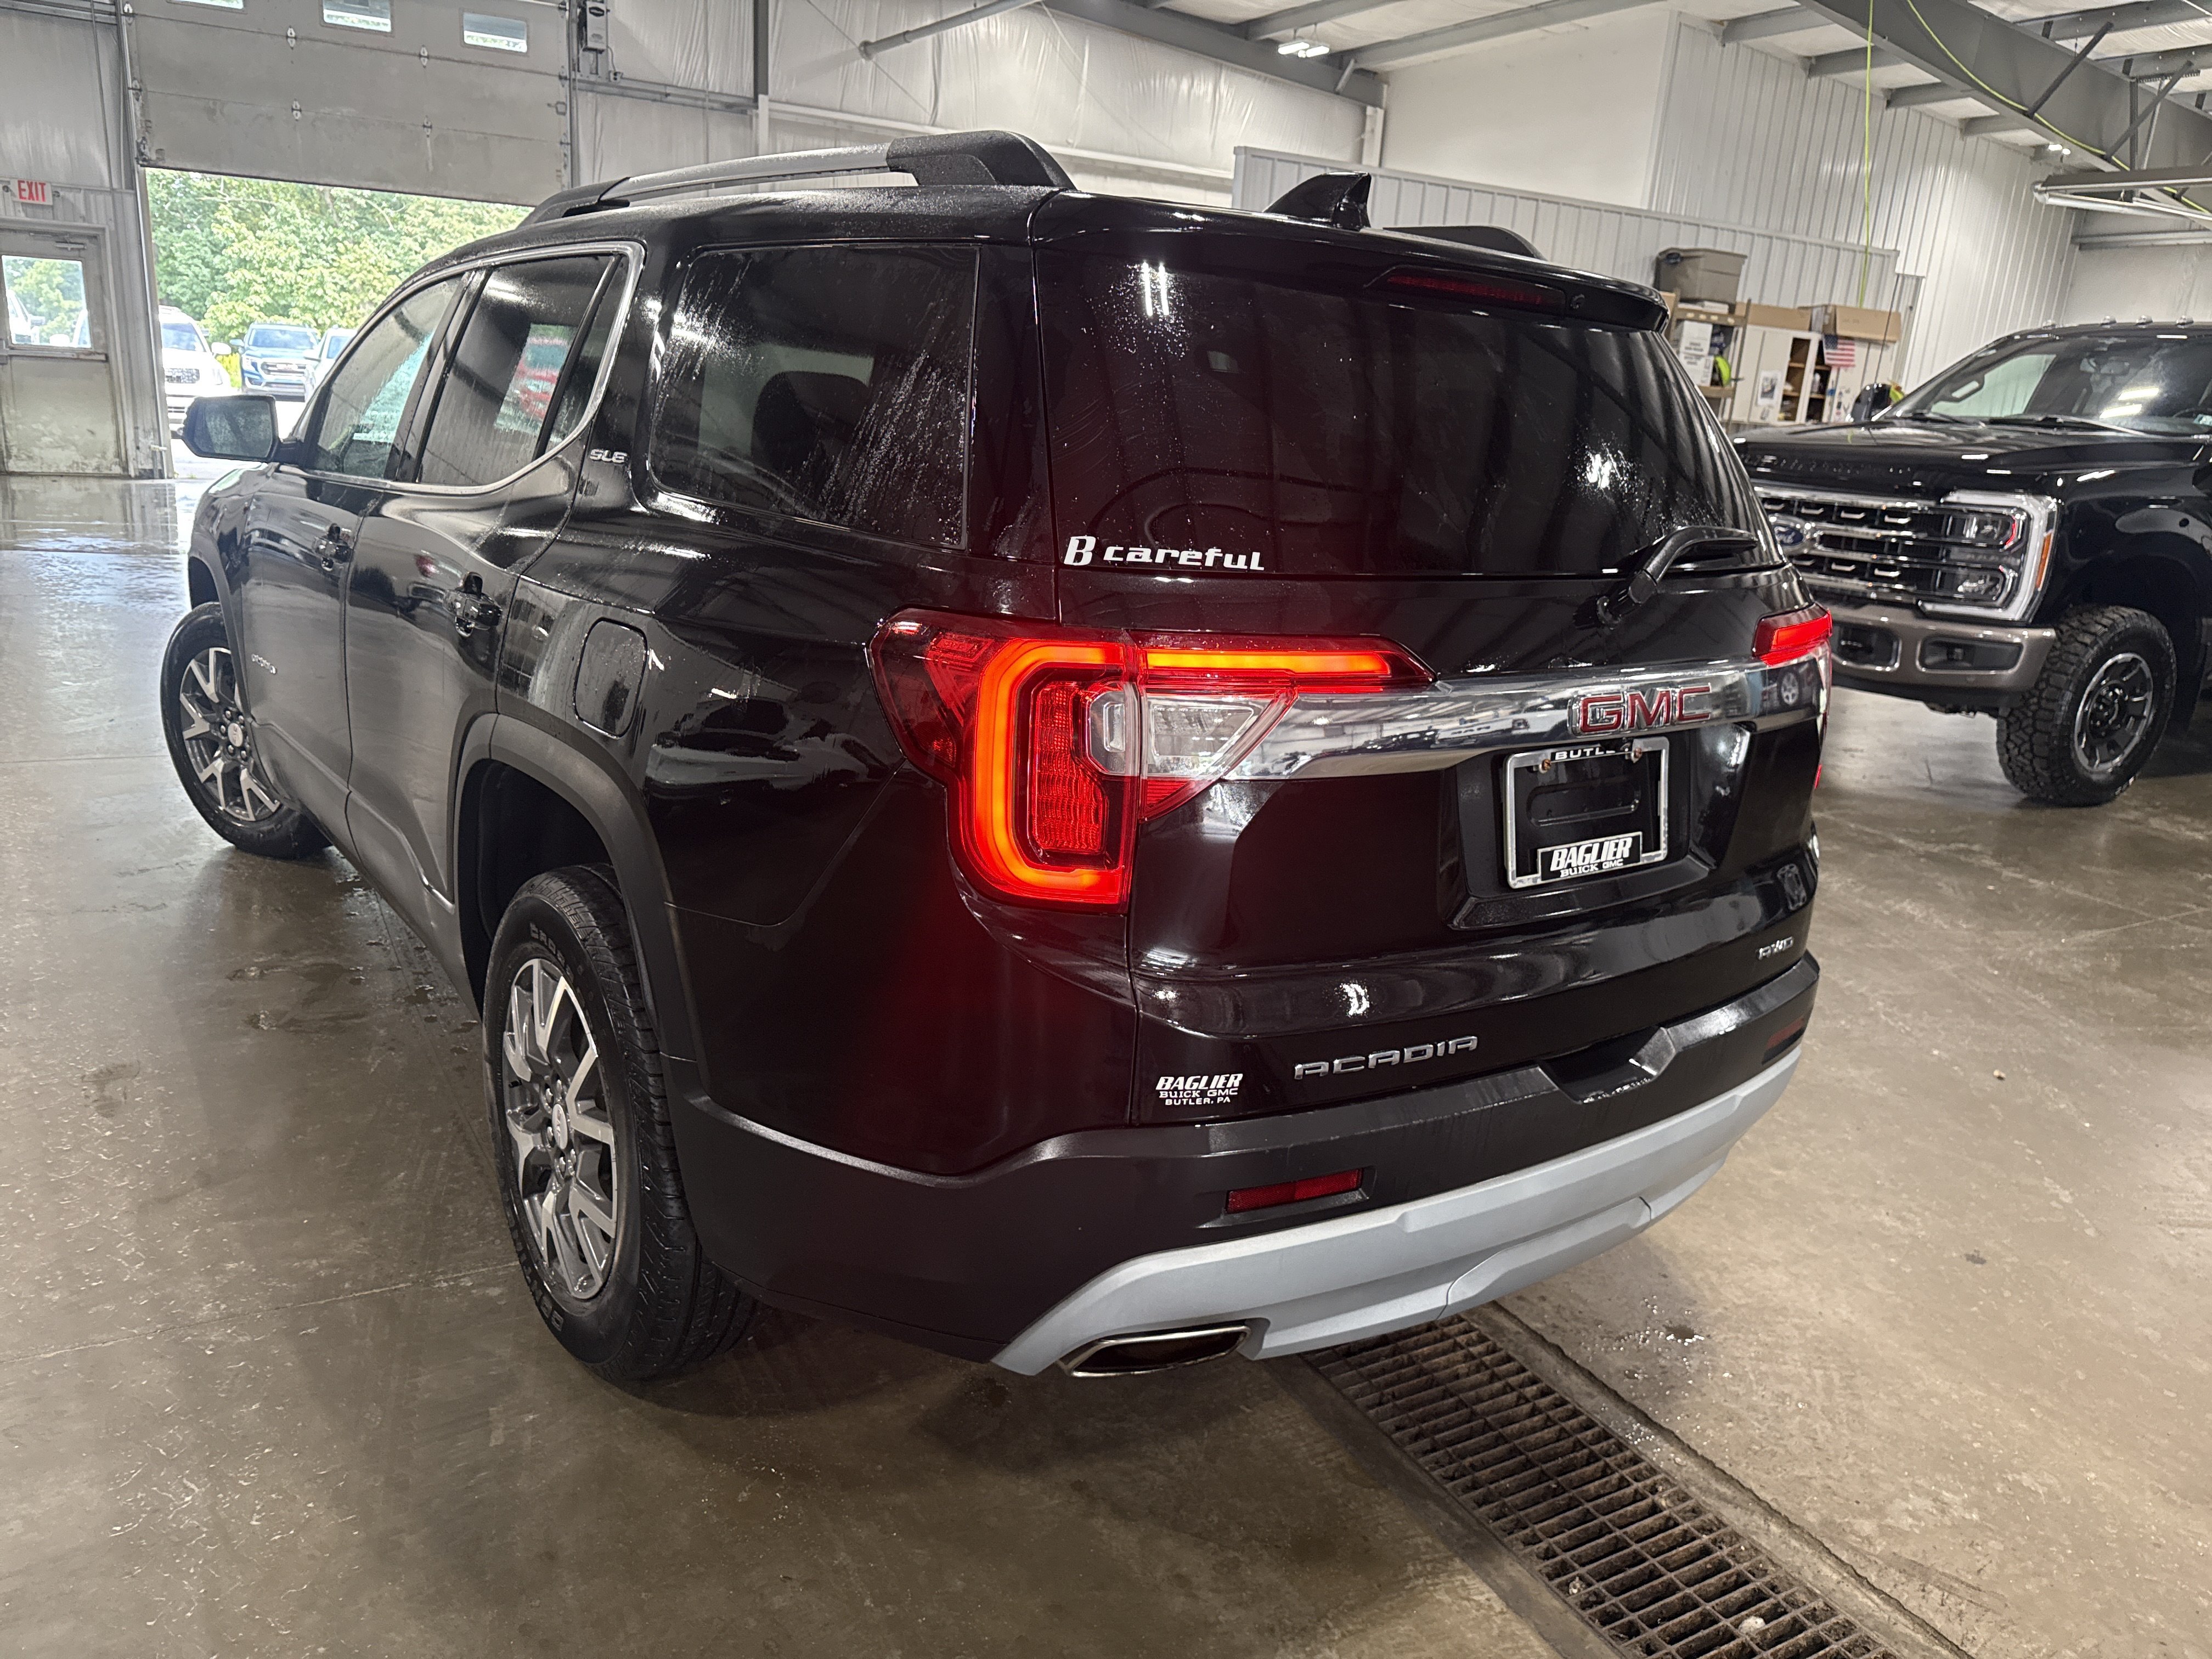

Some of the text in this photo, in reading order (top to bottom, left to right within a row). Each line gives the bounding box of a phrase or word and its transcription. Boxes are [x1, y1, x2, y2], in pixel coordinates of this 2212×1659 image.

[17, 179, 47, 202] EXIT
[589, 448, 628, 464] SLE
[1063, 535, 1265, 570] B careful
[1569, 682, 1712, 734] GMC
[1550, 837, 1633, 871] BAGLIER
[1560, 859, 1624, 878] BUICK GMC
[1294, 1035, 1479, 1080] ACADIA
[1155, 1073, 1244, 1090] BAGLIER
[1207, 1088, 1238, 1097] GMC
